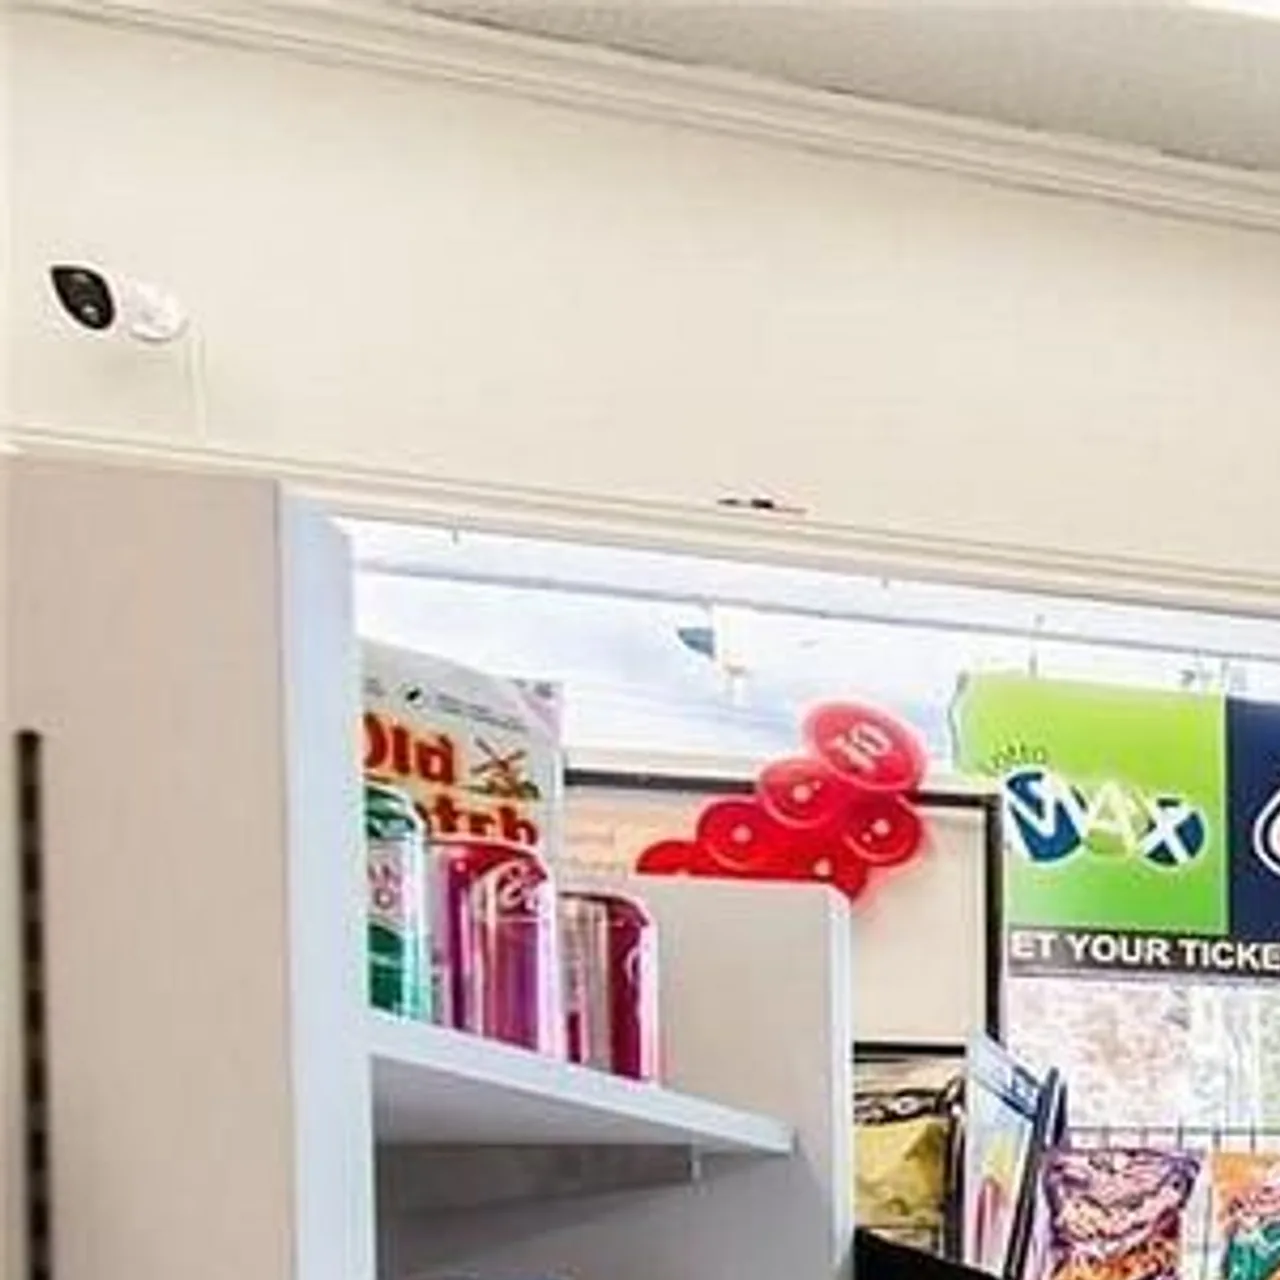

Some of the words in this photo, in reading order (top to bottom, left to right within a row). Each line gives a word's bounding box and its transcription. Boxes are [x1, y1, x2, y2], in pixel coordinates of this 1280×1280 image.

[1000, 765, 1207, 868] MAX
[1010, 931, 1058, 960] ET
[1066, 934, 1171, 966] YOUR
